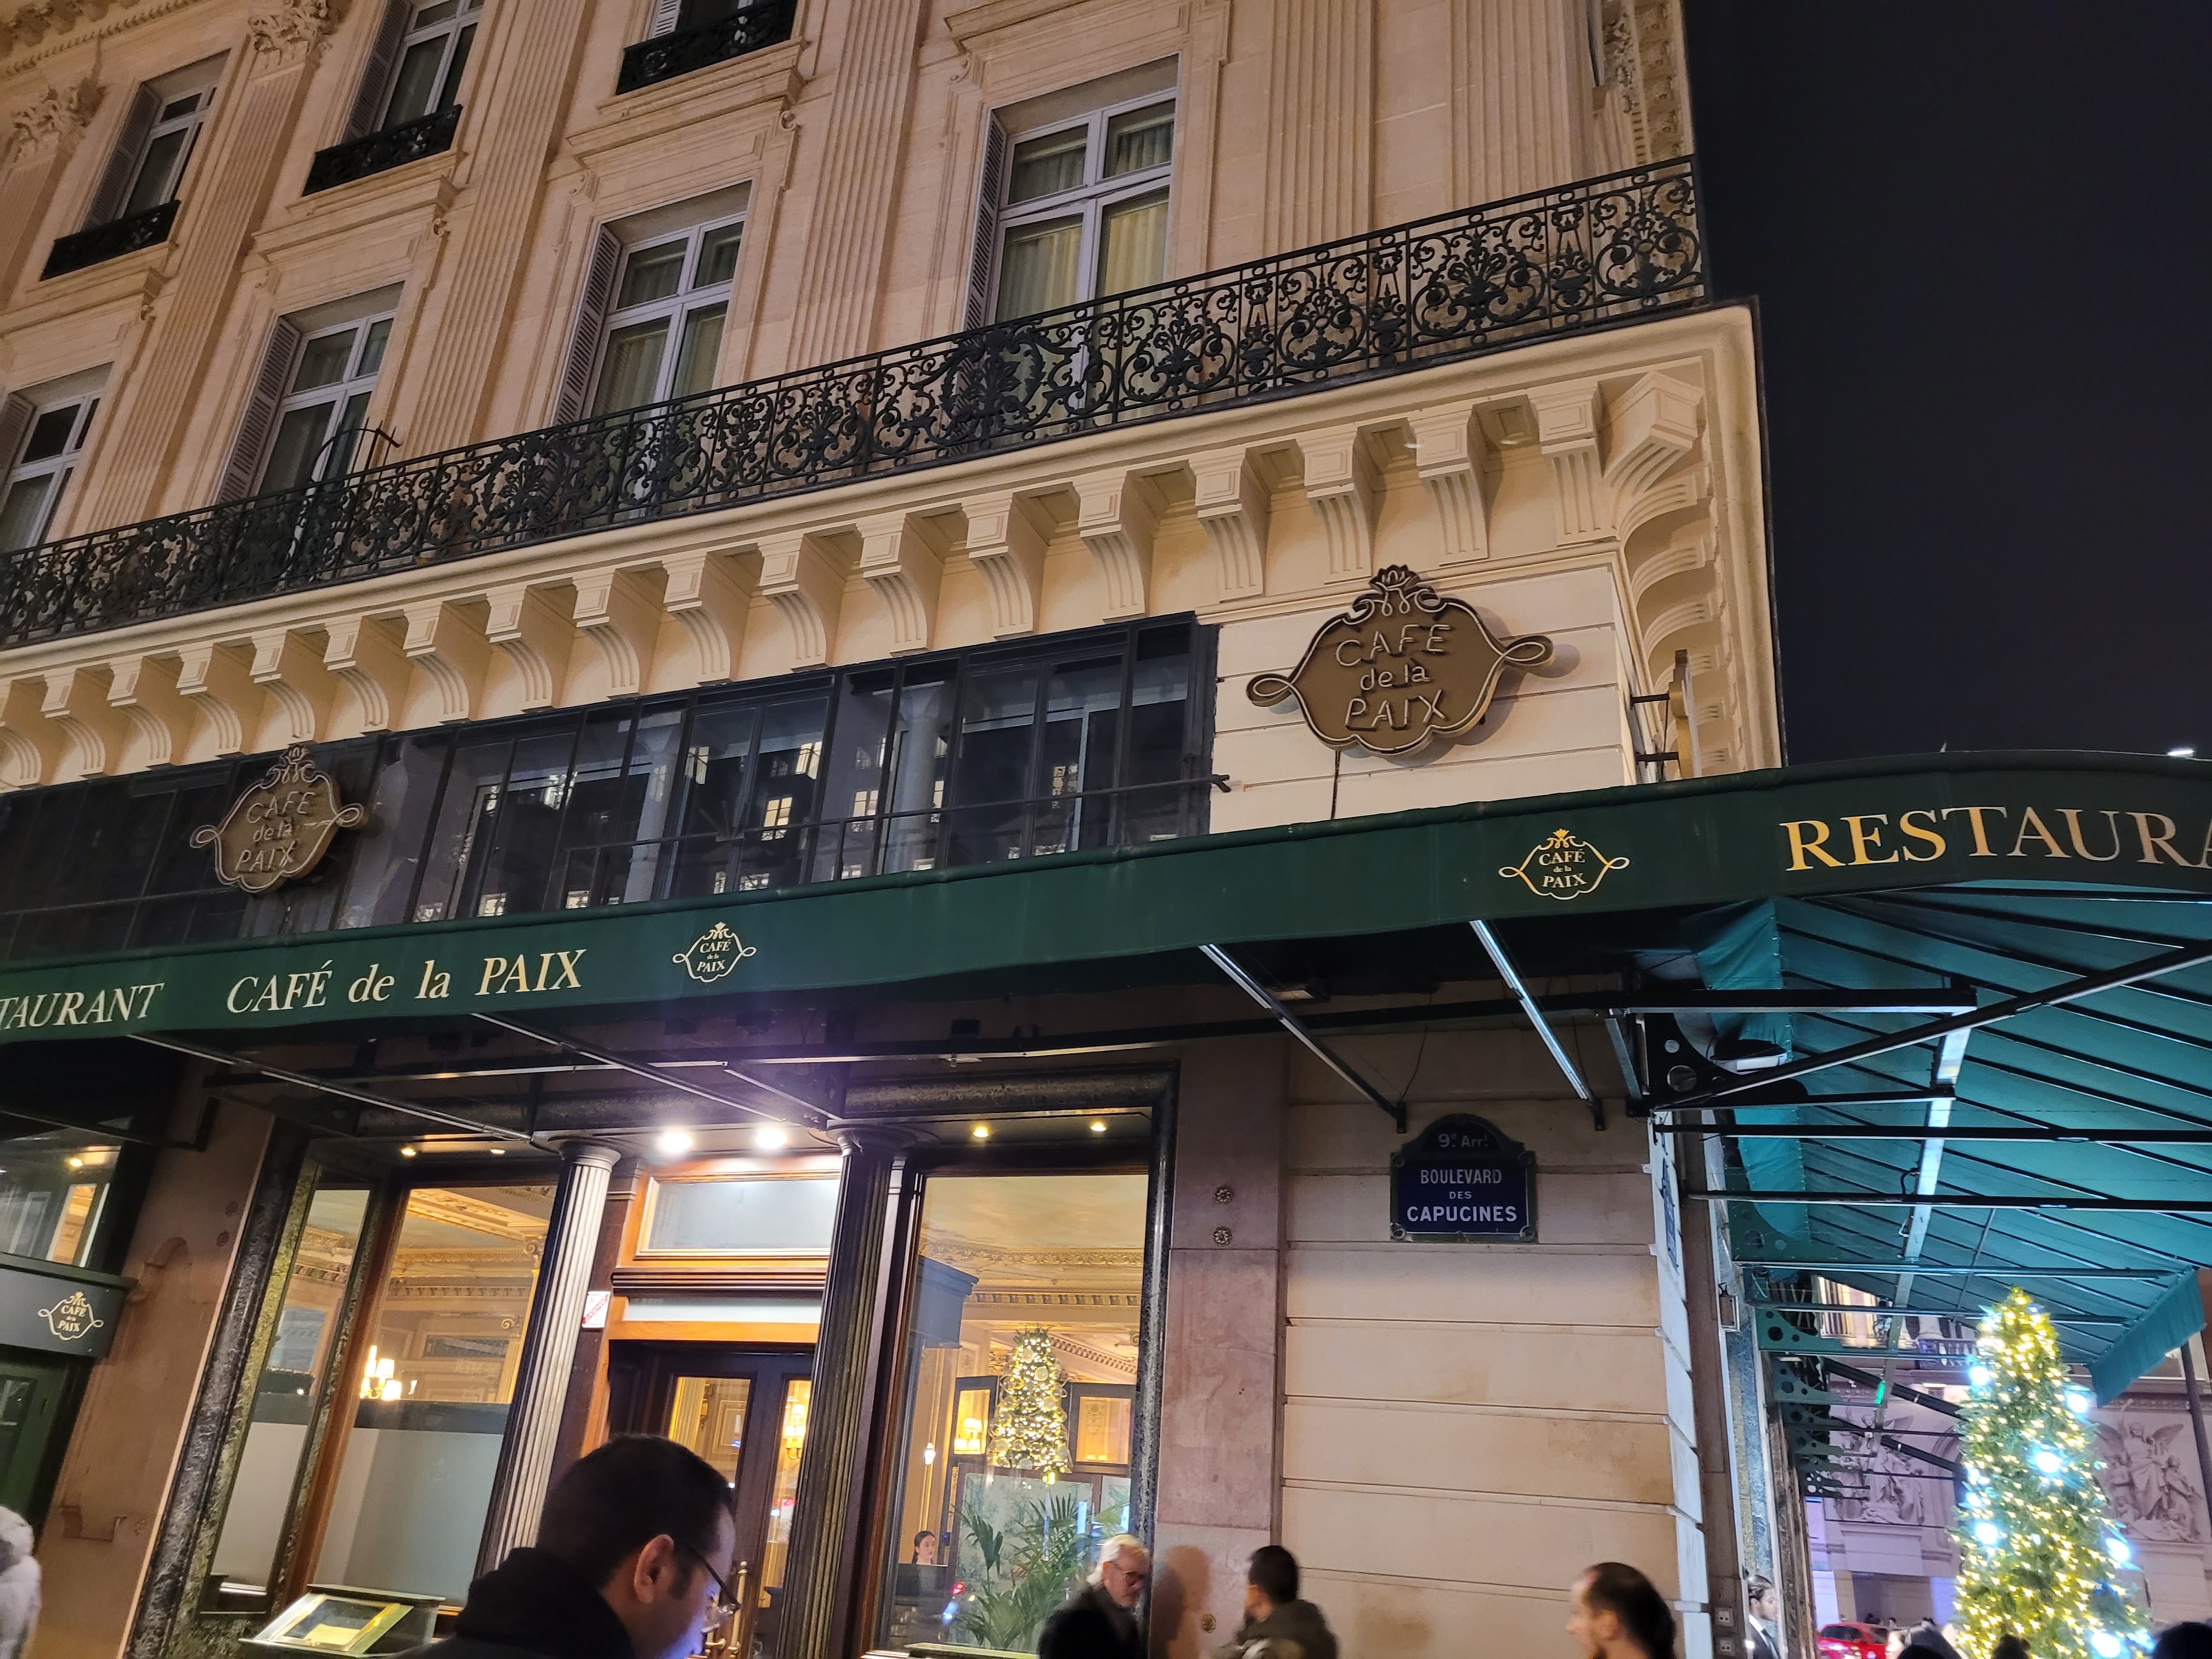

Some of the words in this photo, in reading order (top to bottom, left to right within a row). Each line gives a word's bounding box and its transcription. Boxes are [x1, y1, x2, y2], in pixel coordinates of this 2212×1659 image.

[1360, 668, 1393, 690] de
[1345, 689, 1447, 727] PAIX
[253, 826, 273, 842] de
[235, 840, 296, 872] PAIX
[1538, 849, 1585, 866] CAFÉ
[1541, 873, 1587, 888] PAIX
[699, 939, 732, 953] CAFÉ
[696, 960, 726, 973] PAIX
[227, 960, 334, 1013] CAFÉ
[348, 963, 395, 1003] de
[414, 960, 452, 998] la
[474, 949, 587, 995] PAIX
[1420, 1169, 1502, 1184] BOULEVARD
[1449, 1191, 1472, 1199] DES
[1407, 1206, 1517, 1222] CAPUCINES
[57, 1320, 81, 1332] PAIX
